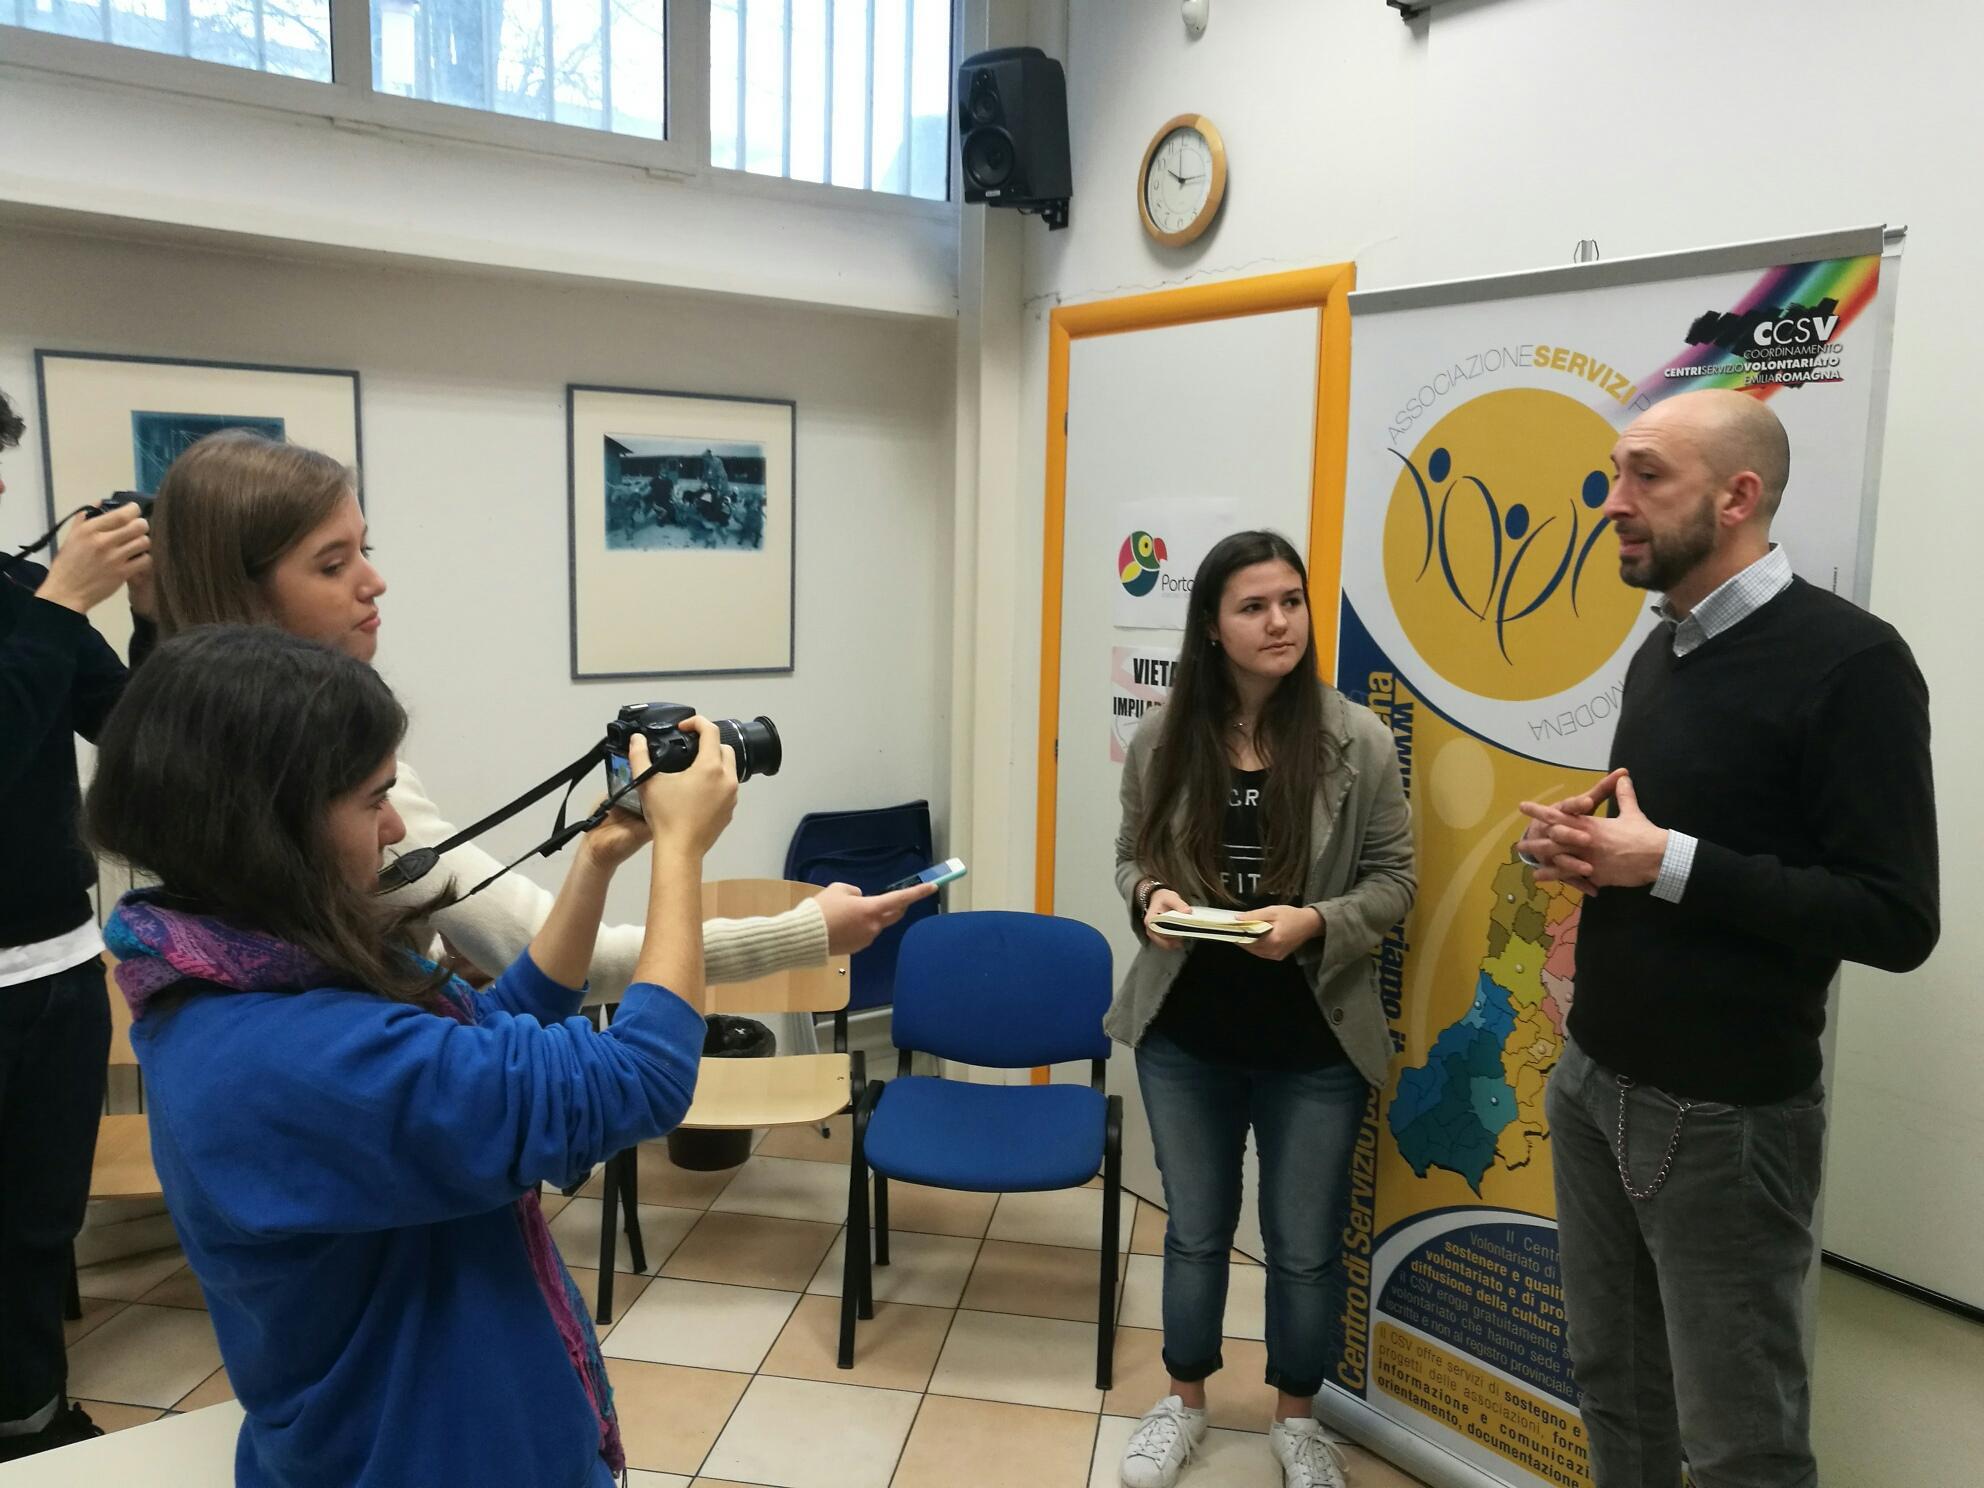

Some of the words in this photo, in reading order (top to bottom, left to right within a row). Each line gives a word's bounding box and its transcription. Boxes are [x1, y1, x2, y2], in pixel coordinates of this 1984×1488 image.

[1743, 343, 1843, 360] COORDINAMENTO
[1753, 315, 1839, 346] CCSV
[1342, 1126, 1377, 1255] Servizio
[1341, 1250, 1371, 1287] di
[1425, 1249, 1504, 1293] volontariato
[1507, 1286, 1517, 1299] e
[1521, 1290, 1535, 1307] di
[1540, 1300, 1567, 1321] pro
[1444, 1240, 1508, 1277] sostenere
[1511, 1270, 1521, 1283] e
[1470, 1231, 1540, 1273] Volontariato
[1544, 1264, 1557, 1280] di
[1390, 1285, 1457, 1323] volontariato
[1461, 1317, 1483, 1336] che
[1487, 1327, 1526, 1356] hanno
[1530, 1350, 1561, 1374] sede
[1410, 1259, 1473, 1296] diffusione
[1475, 1289, 1508, 1313] della
[1511, 1305, 1561, 1337] cultura
[1410, 1274, 1433, 1295] CSV
[1437, 1288, 1469, 1312] eroga
[1472, 1305, 1558, 1353] gratuitamente
[1335, 1286, 1369, 1390] Centro
[1431, 1319, 1452, 1336] non
[1465, 1335, 1508, 1365] registro
[1510, 1358, 1574, 1398] provinciale
[1377, 1357, 1469, 1415] informazione
[1481, 1413, 1488, 1425] e
[1499, 1423, 1591, 1480] comunicazi
[1378, 1344, 1423, 1374] progetti
[1429, 1369, 1457, 1392] delle
[1553, 1431, 1588, 1460] form
[1390, 1331, 1413, 1351] CSV
[1416, 1345, 1442, 1367] offre
[1447, 1361, 1484, 1389] servizi
[1488, 1381, 1499, 1397] di
[1504, 1391, 1567, 1431] sostegno
[1572, 1425, 1582, 1438] e
[1377, 1376, 1462, 1431] orientamento,
[1467, 1422, 1580, 1488] documentazione
